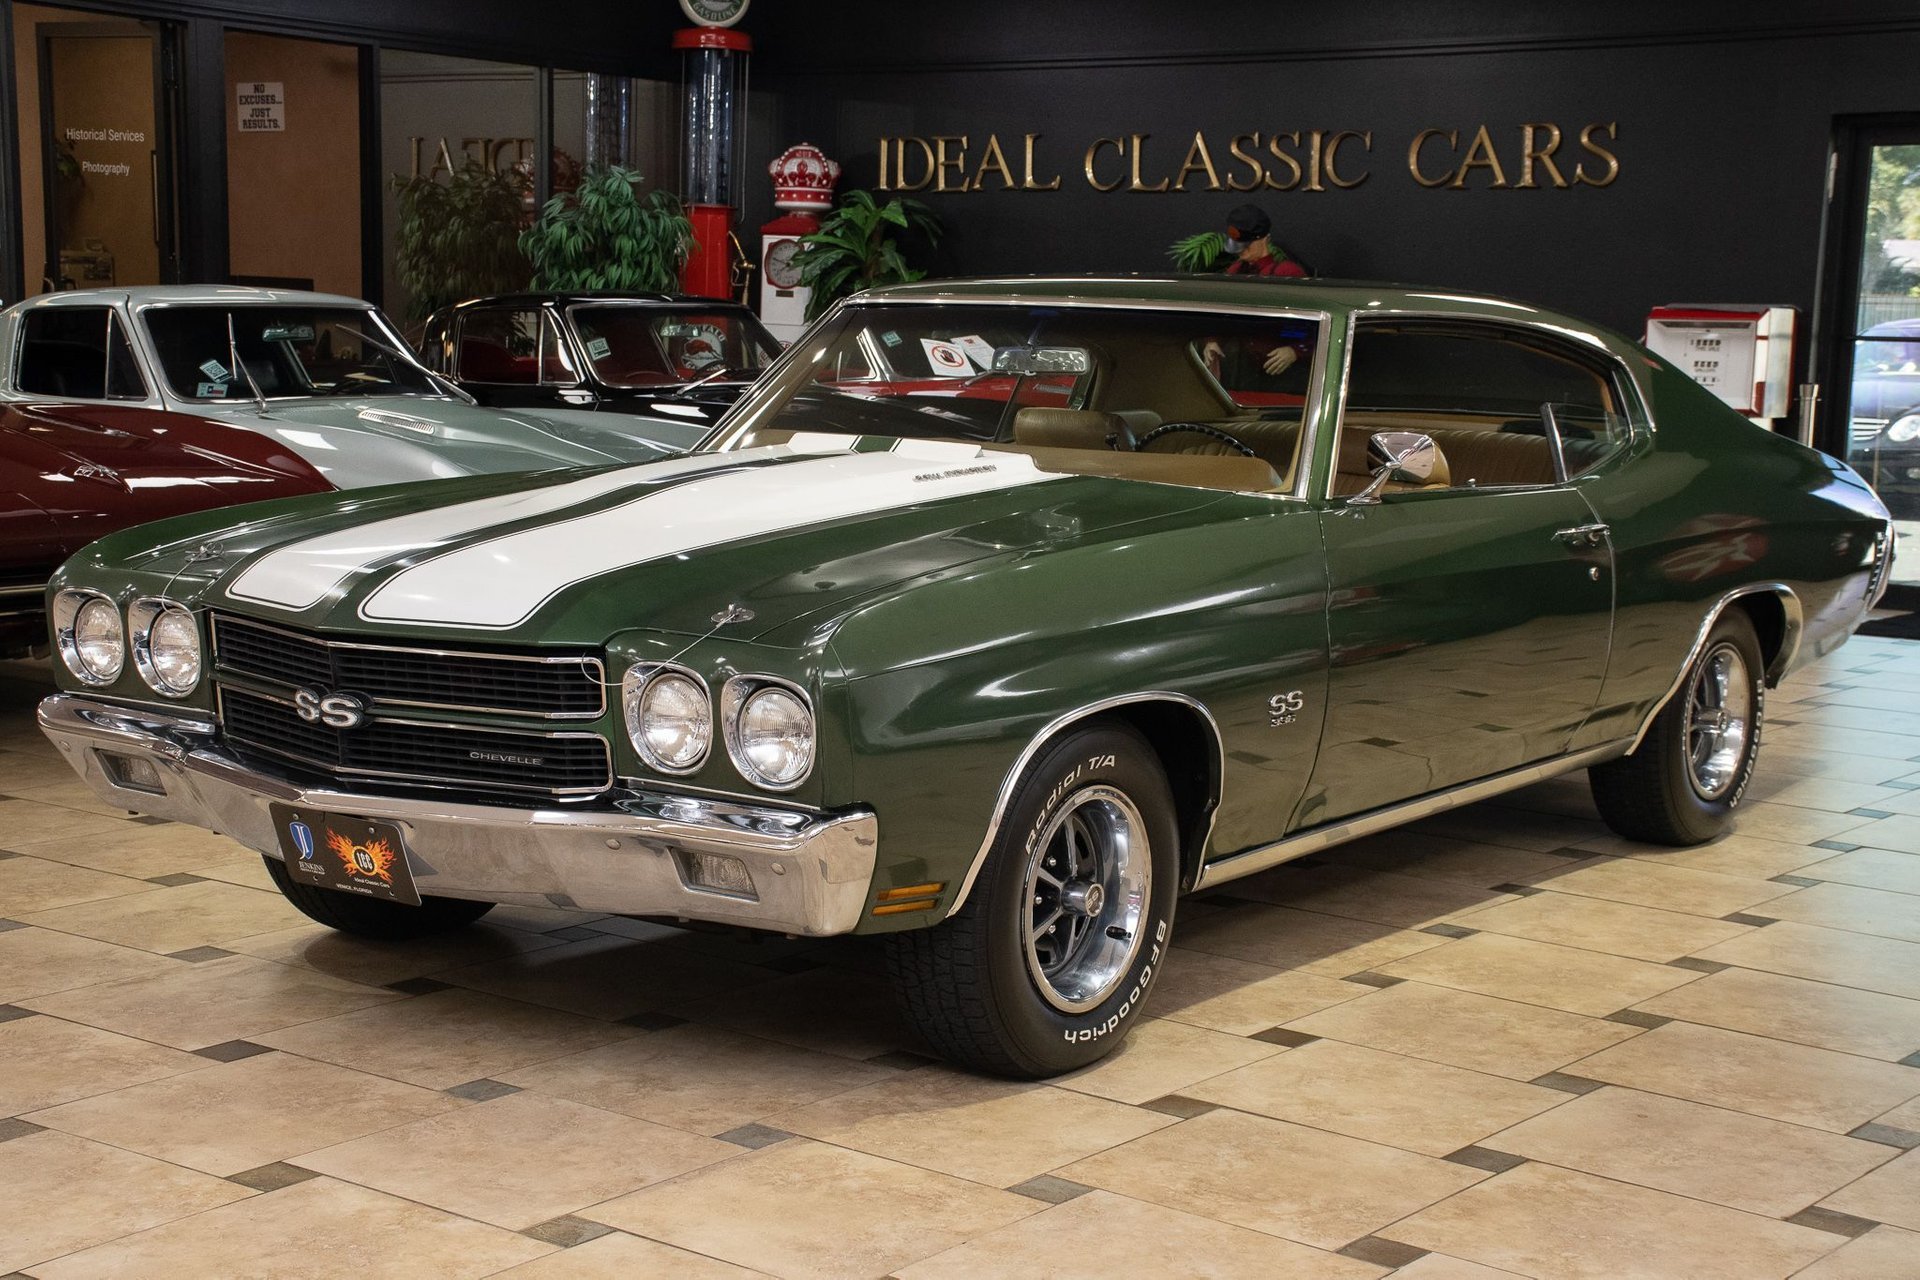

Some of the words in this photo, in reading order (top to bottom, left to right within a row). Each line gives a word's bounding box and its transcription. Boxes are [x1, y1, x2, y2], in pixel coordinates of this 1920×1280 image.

[253, 84, 265, 93] NO
[250, 108, 271, 118] JUST
[243, 119, 281, 129] RESULTS.
[66, 127, 107, 141] Historical
[108, 128, 145, 142] Services
[874, 132, 1061, 194] IDEAL
[1083, 128, 1373, 194] CLASSIC
[1407, 121, 1621, 191] CARS
[82, 161, 130, 176] Photography
[295, 686, 363, 728] SS
[1268, 690, 1304, 715] SS
[469, 751, 542, 766] CHEVELLE
[1025, 764, 1082, 855] Radial
[1088, 754, 1116, 770] T/A
[1064, 919, 1167, 1043] BFGoodrich
